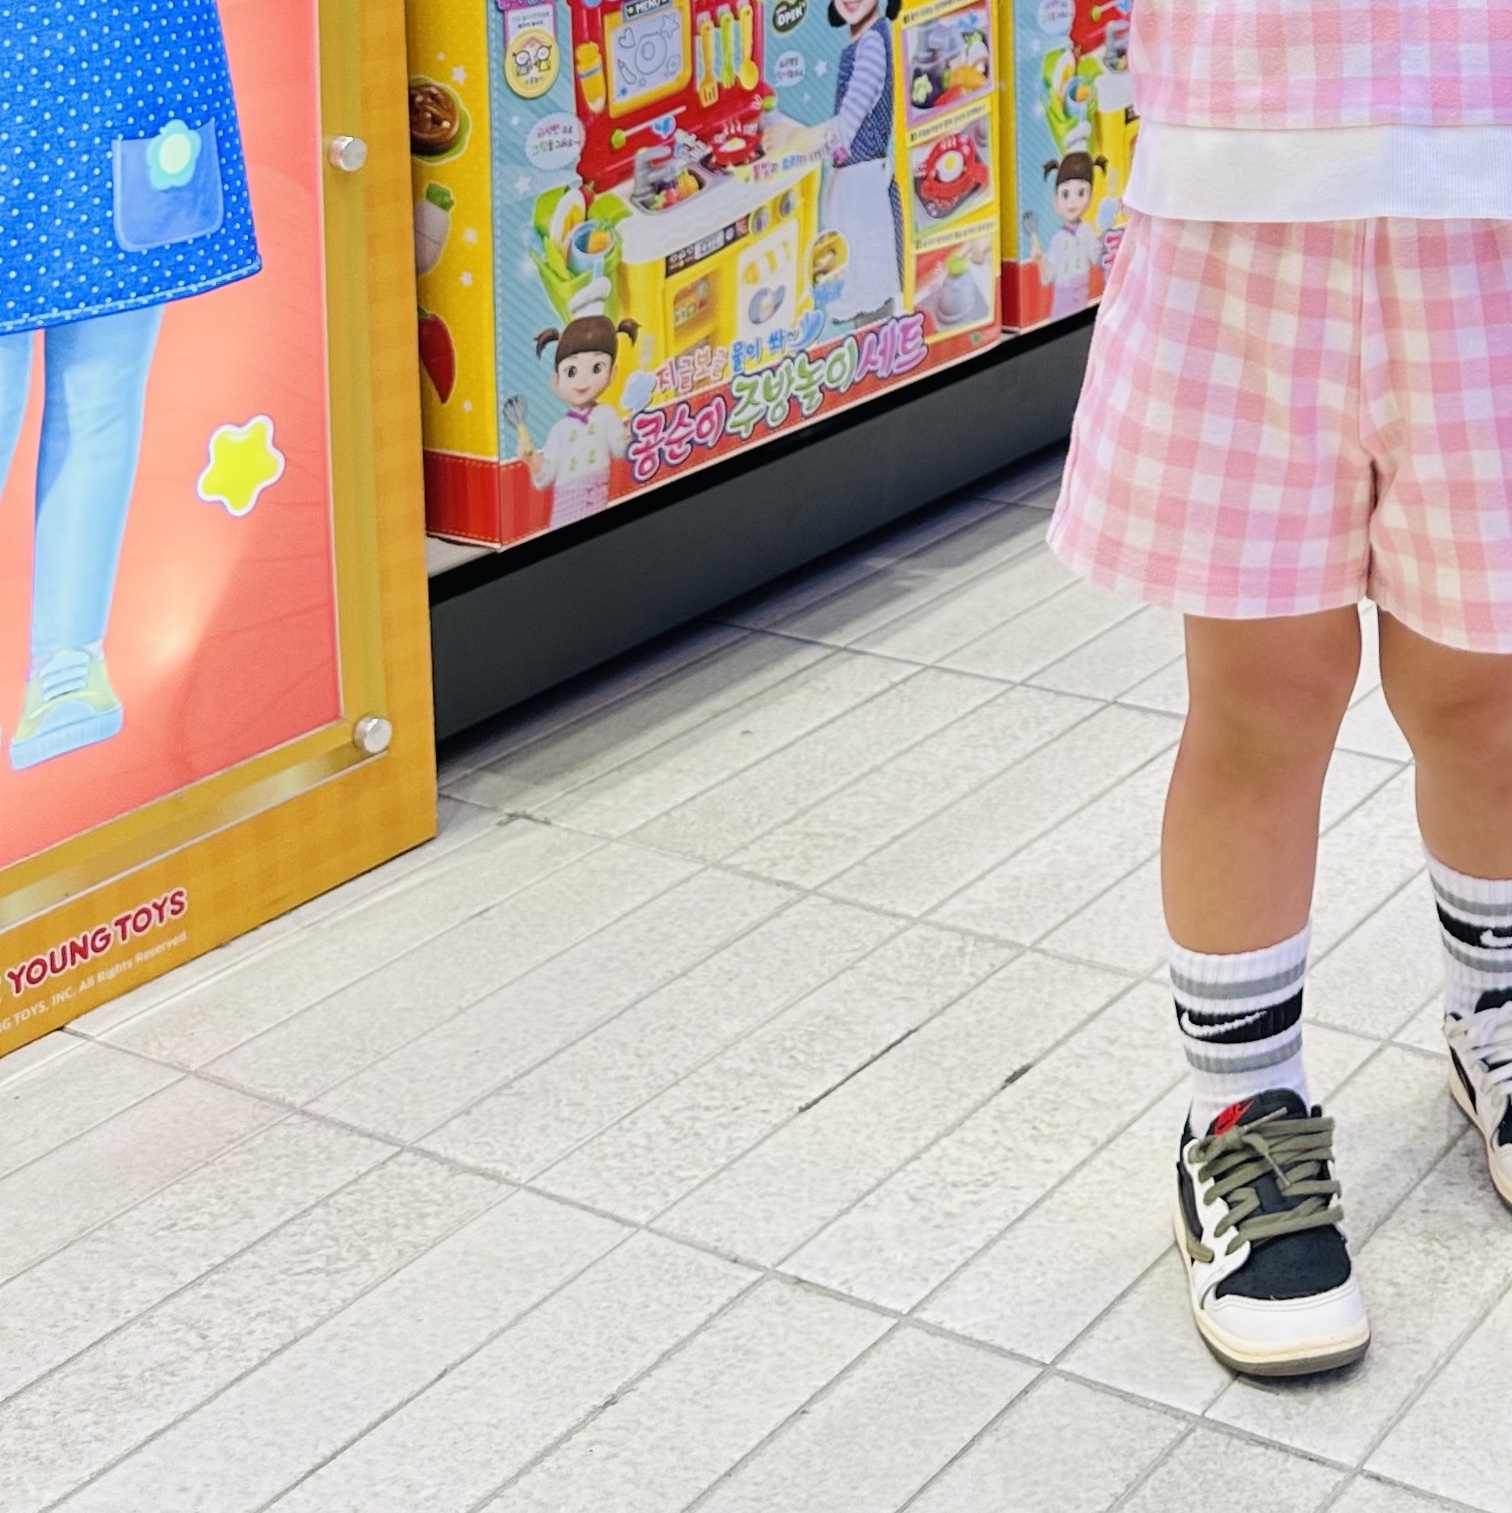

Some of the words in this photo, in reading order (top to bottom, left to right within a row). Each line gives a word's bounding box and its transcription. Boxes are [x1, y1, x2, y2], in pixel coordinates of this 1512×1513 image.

[655, 346, 729, 392] 지글보글
[731, 337, 763, 373] 물이
[627, 396, 727, 483] 콩순이
[6, 926, 113, 995] YOUNG
[114, 889, 187, 943] TOYS
[79, 975, 95, 992] All
[97, 960, 134, 983] Rights
[135, 932, 189, 964] Reserved.
